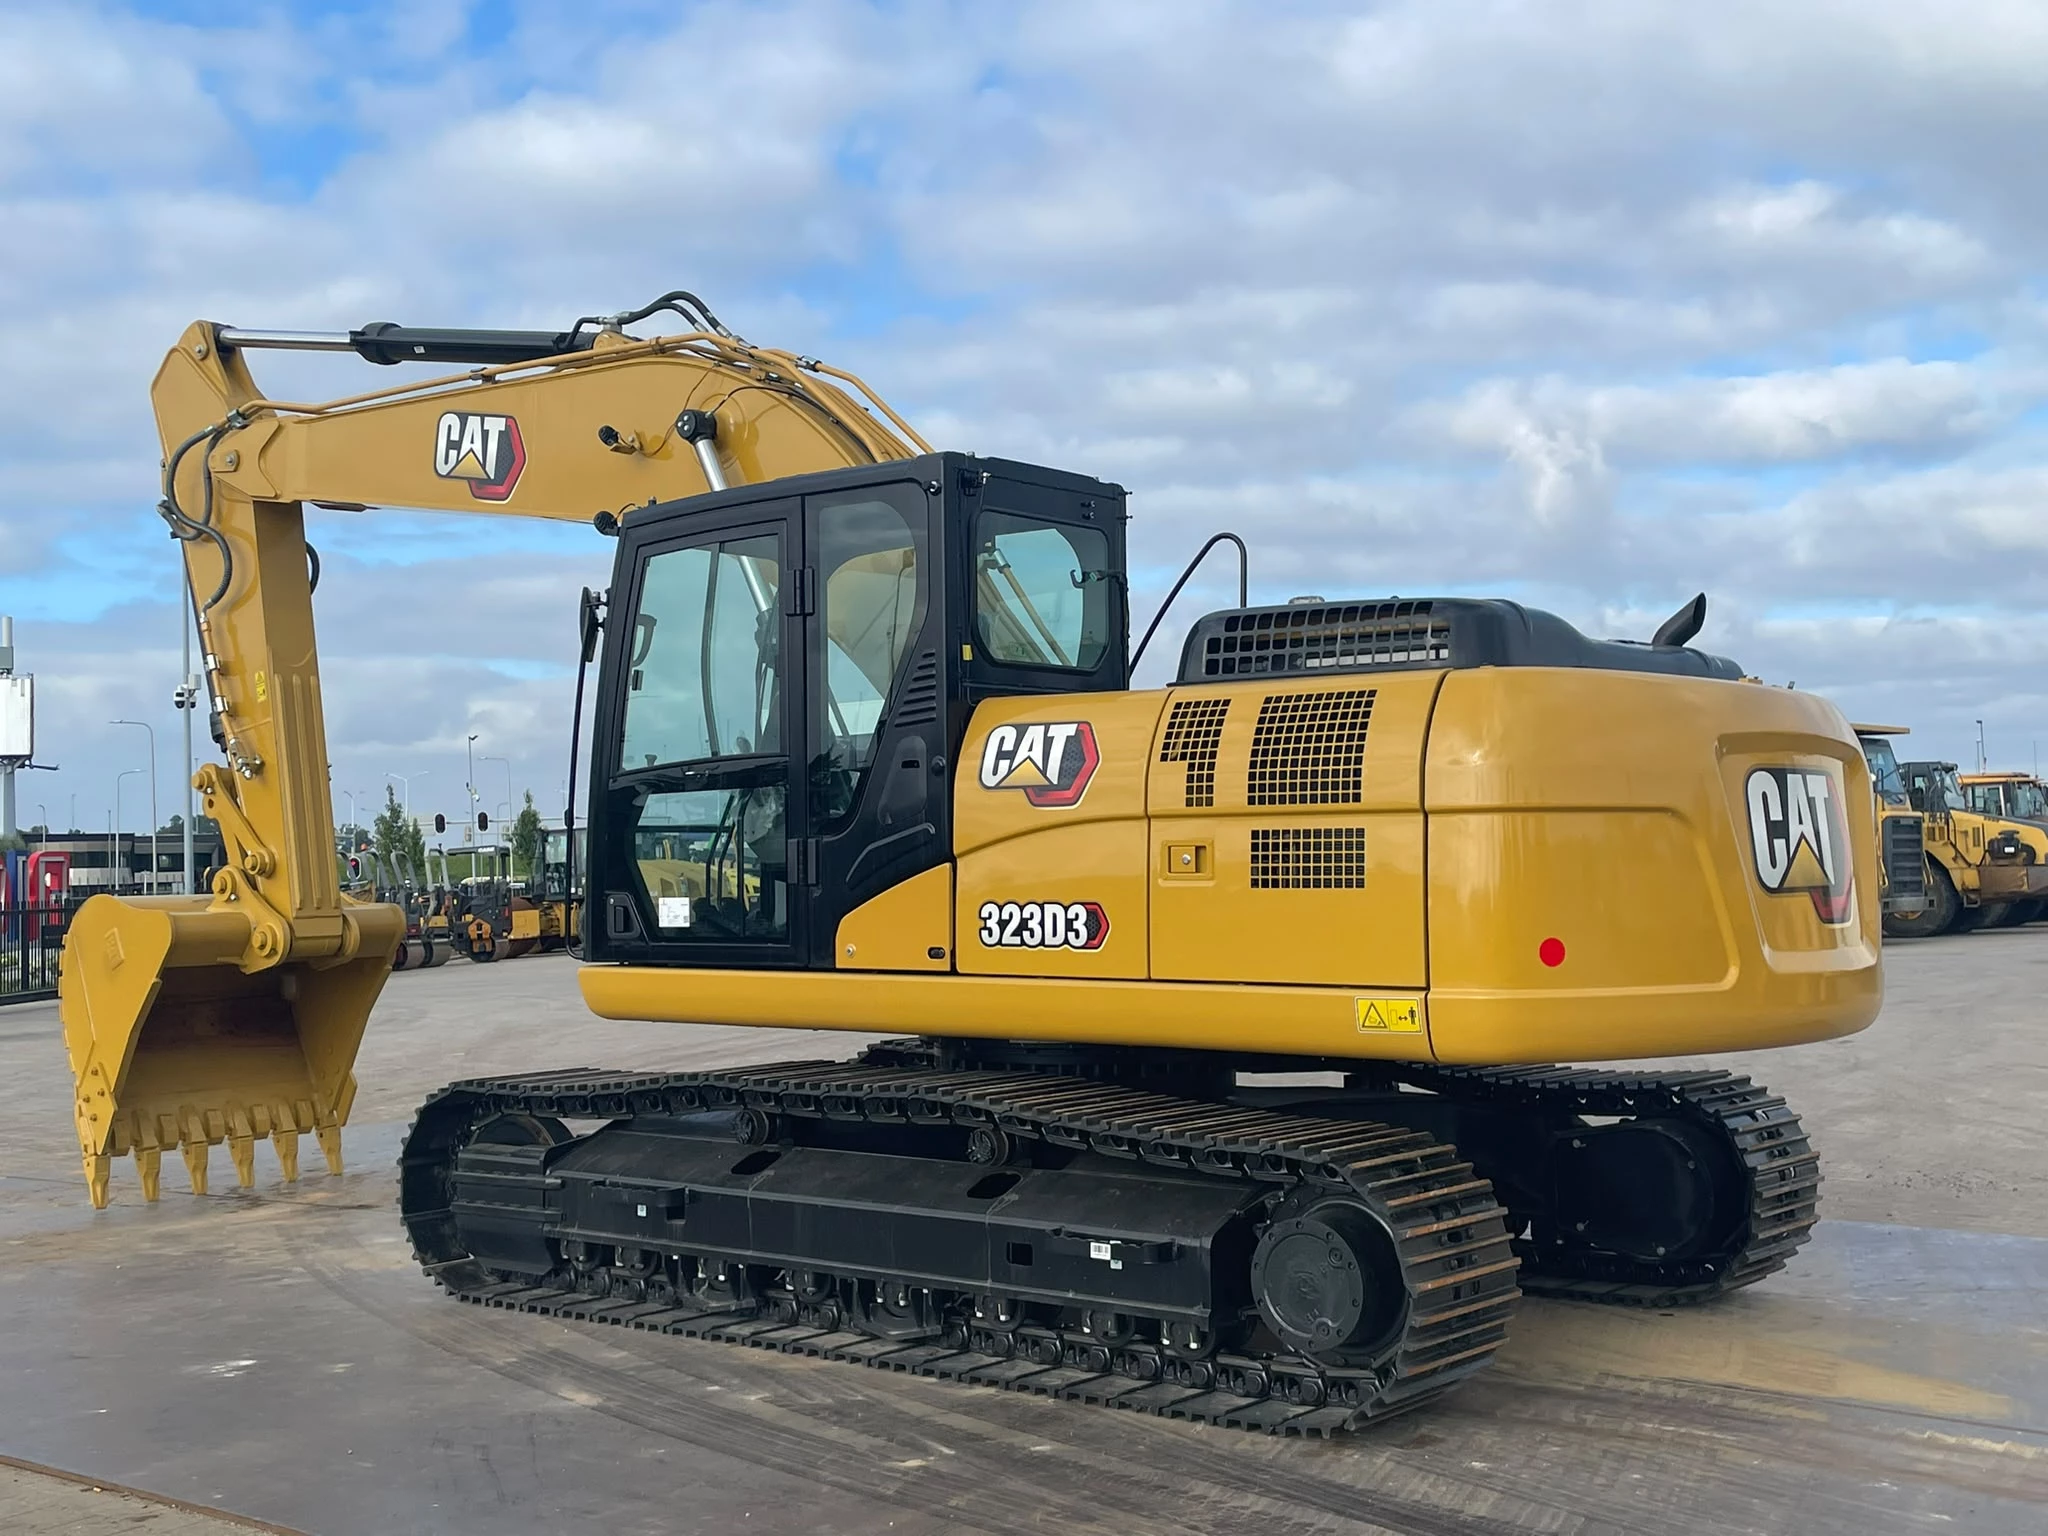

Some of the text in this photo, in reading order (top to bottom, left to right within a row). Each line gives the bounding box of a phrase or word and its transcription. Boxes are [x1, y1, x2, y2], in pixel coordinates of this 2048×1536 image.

[436, 413, 506, 479] CAT
[981, 724, 1078, 787] CAT
[1747, 770, 1835, 889] CAT
[980, 903, 1088, 947] 323D3
